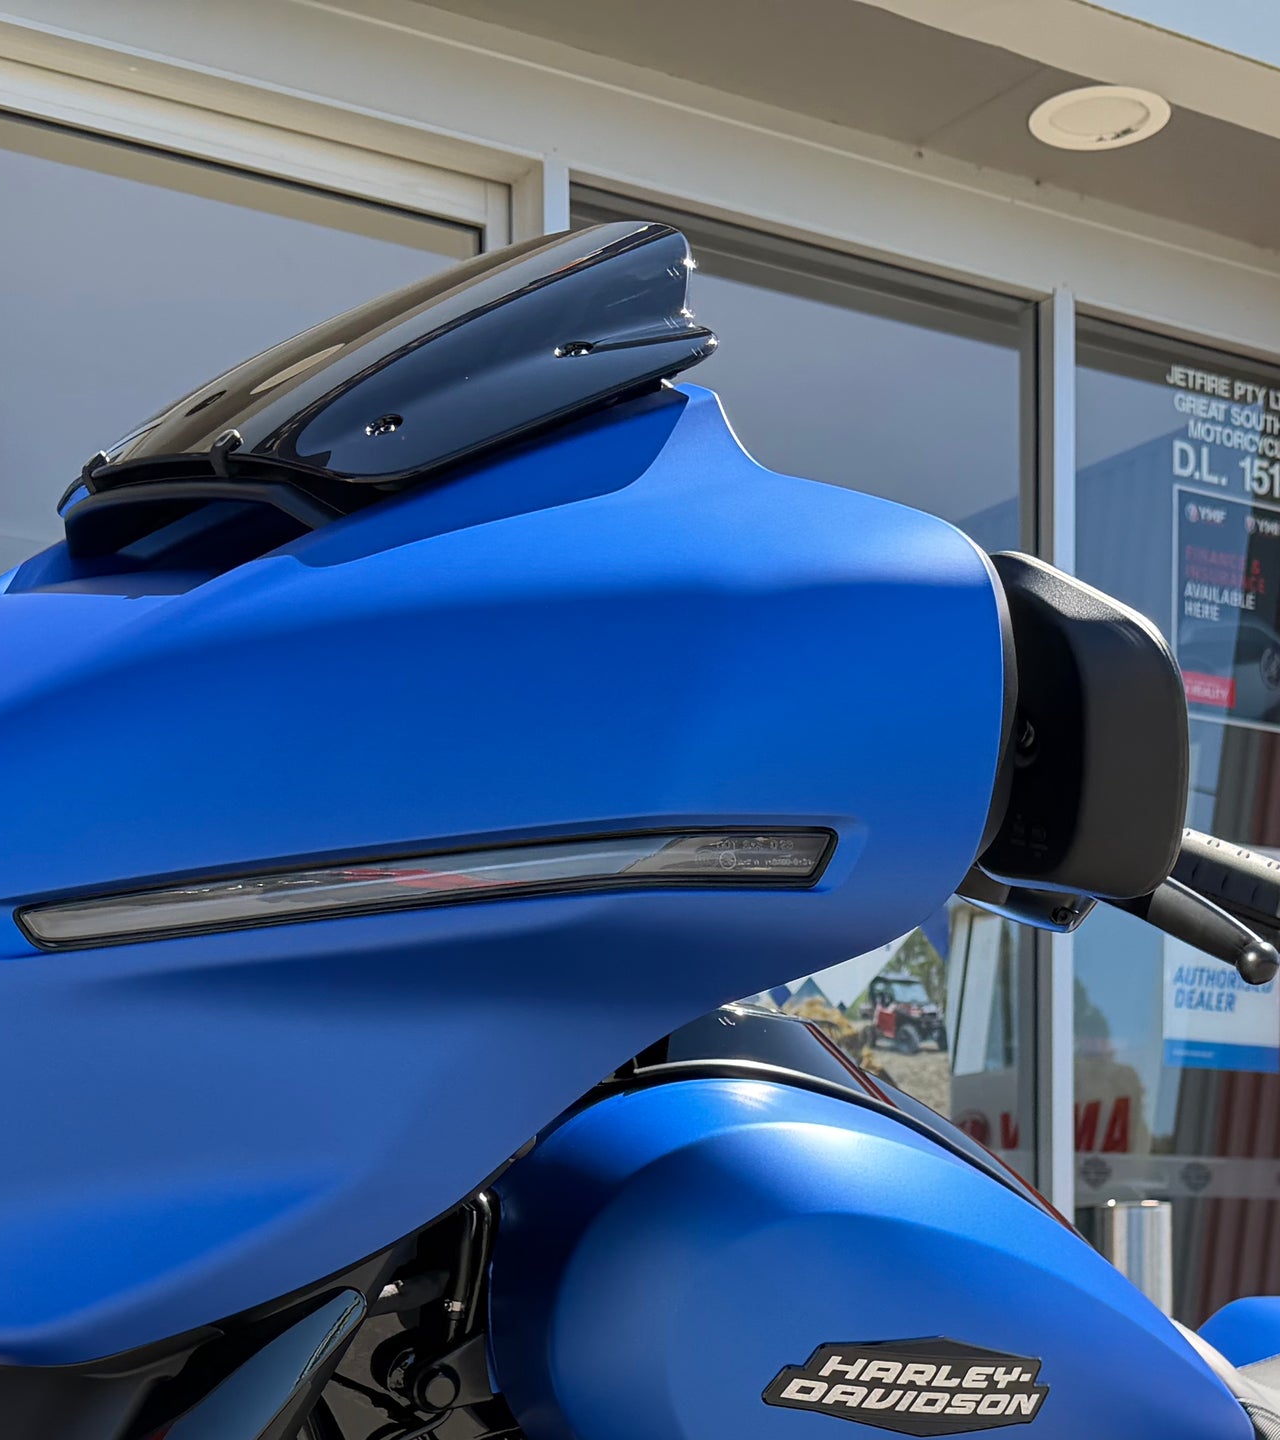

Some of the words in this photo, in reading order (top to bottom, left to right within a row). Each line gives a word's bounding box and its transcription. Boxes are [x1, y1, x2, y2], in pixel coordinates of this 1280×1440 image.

[1166, 366, 1230, 398] JETFIRE
[1234, 383, 1267, 404] PTY
[1174, 393, 1226, 420] GREAT
[1172, 441, 1227, 486] D.L.
[1184, 581, 1256, 610] AVAILABLE
[1184, 600, 1220, 621] HERE
[1175, 989, 1236, 1013] DEALER
[818, 1355, 1032, 1388] HARLEY-
[780, 1378, 1040, 1416] DAVIDSON
